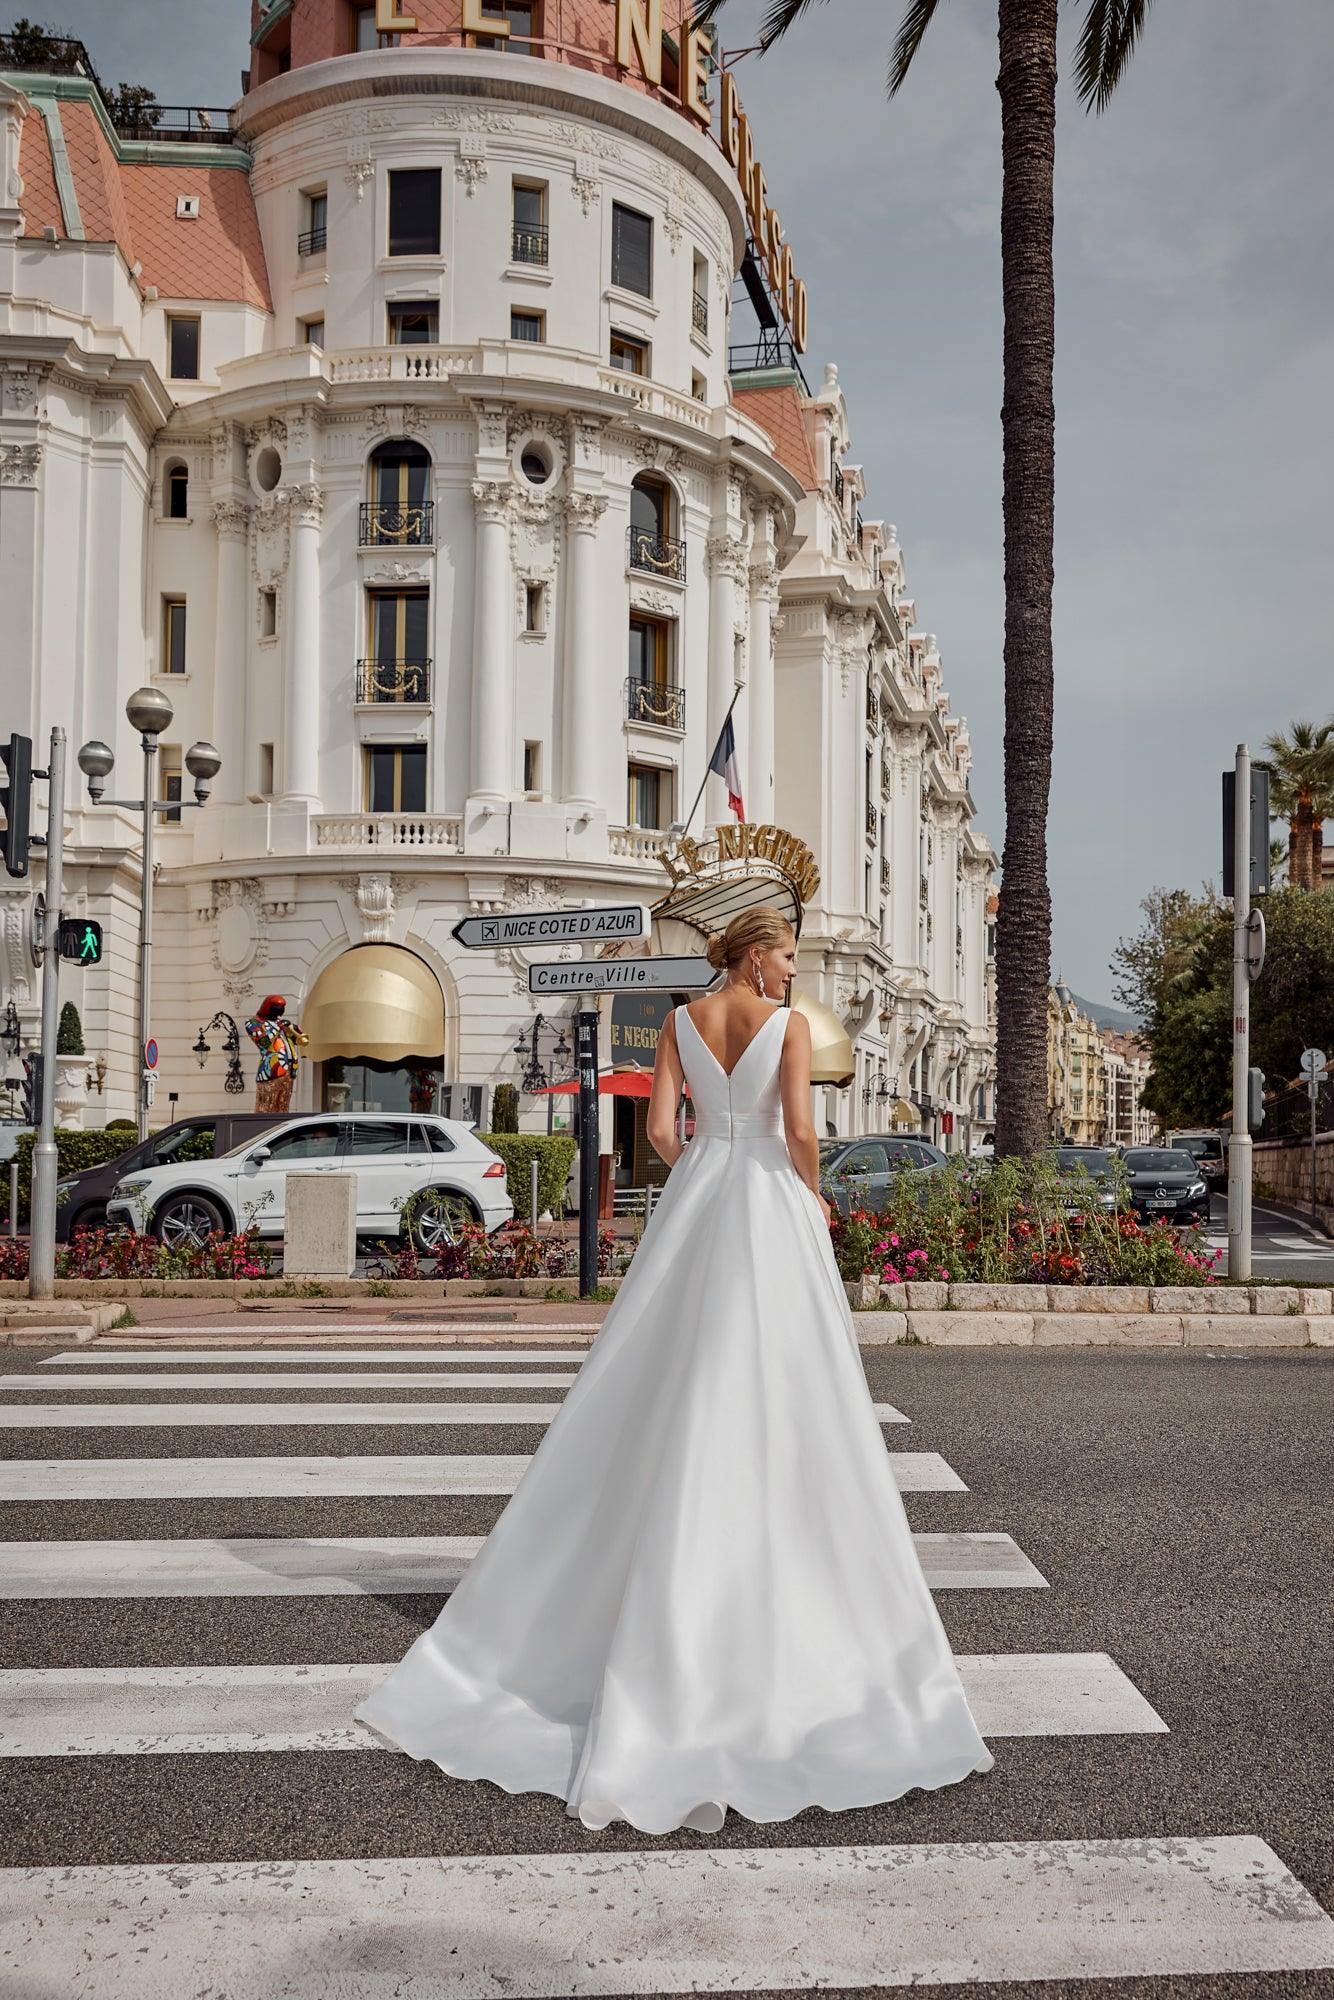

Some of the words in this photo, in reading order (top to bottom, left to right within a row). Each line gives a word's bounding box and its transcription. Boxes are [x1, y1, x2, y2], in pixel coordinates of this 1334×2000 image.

[503, 921, 536, 938] NICE
[539, 918, 577, 935] COTE
[537, 970, 594, 986] Centre
[605, 967, 646, 983] Ville
[624, 1025, 662, 1049] NEGR
